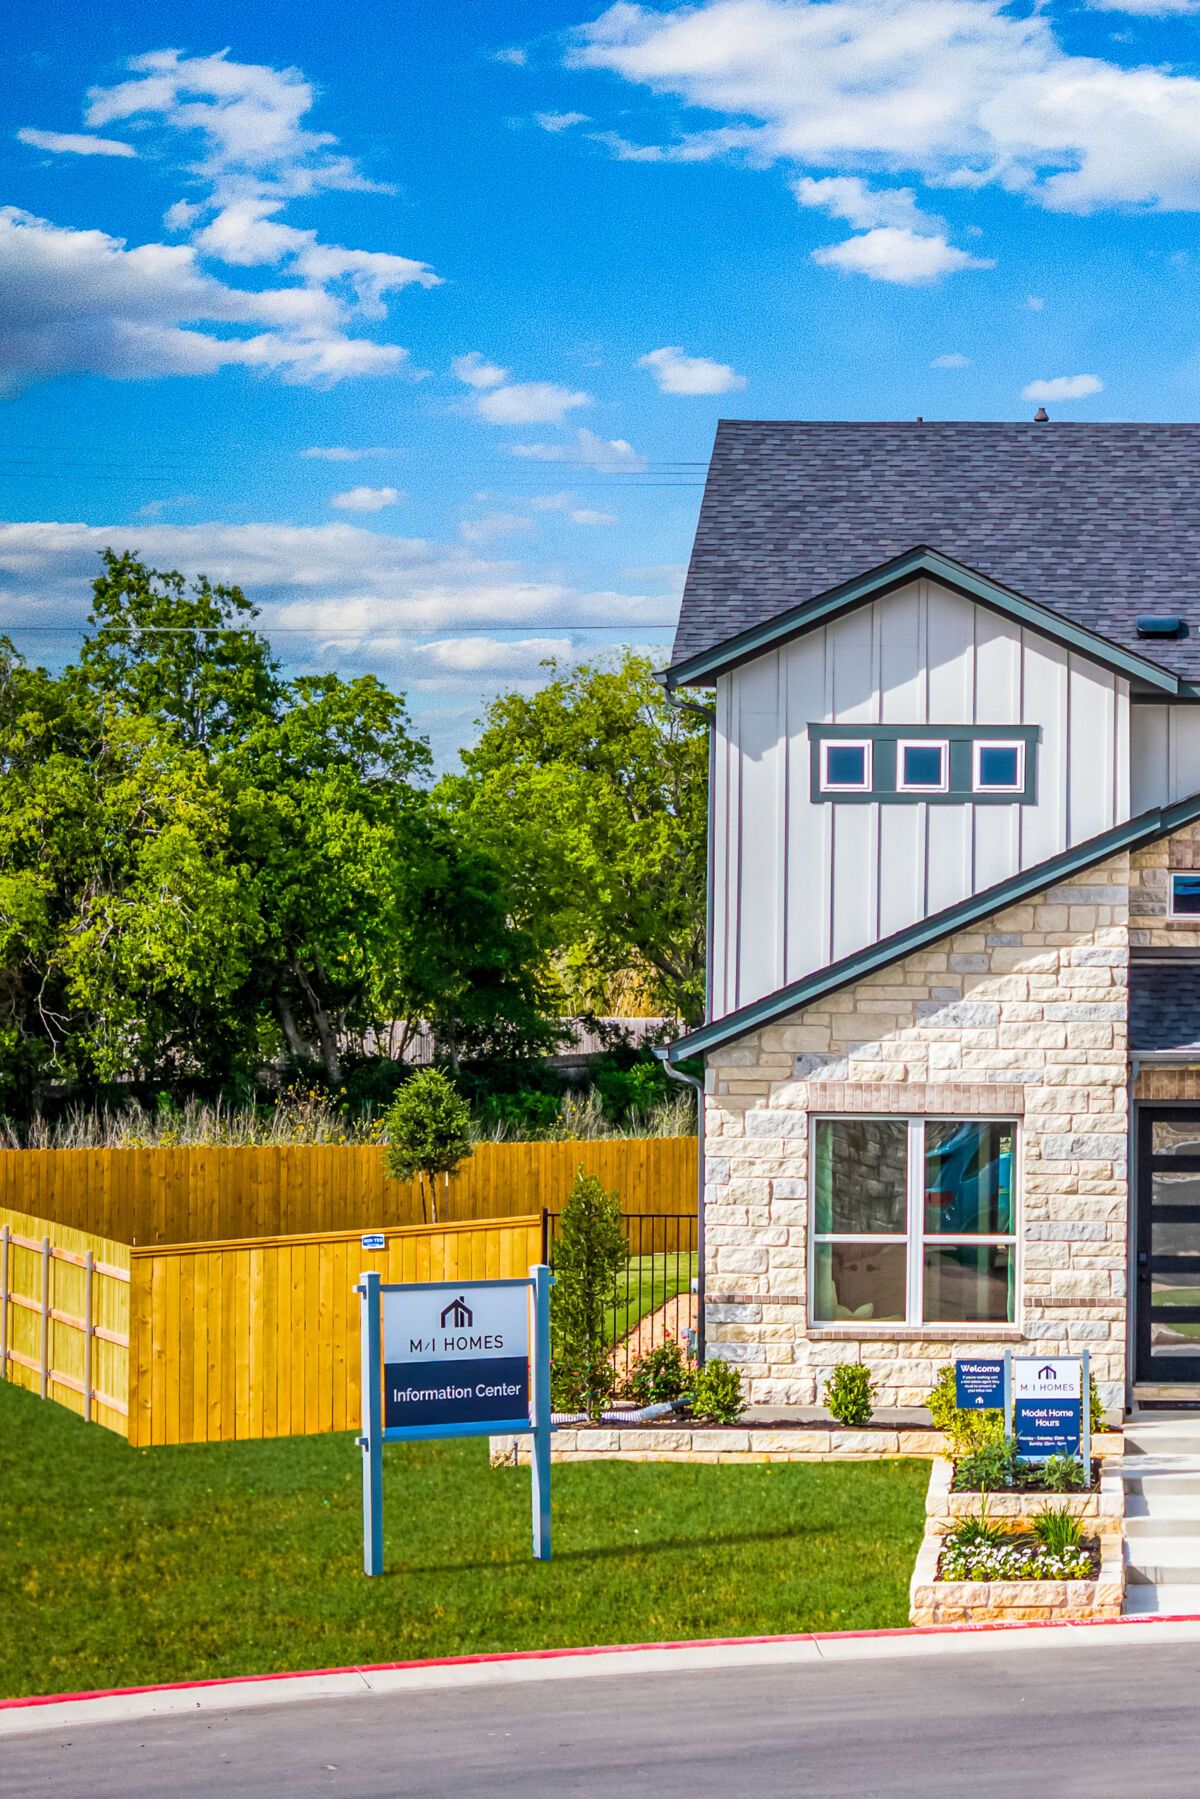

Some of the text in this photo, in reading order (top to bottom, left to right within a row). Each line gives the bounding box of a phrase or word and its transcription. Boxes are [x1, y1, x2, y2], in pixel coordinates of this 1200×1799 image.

[410, 1335, 504, 1353] M/I HOMES
[960, 1364, 1000, 1372] Welcome
[393, 1382, 522, 1403] Information Center
